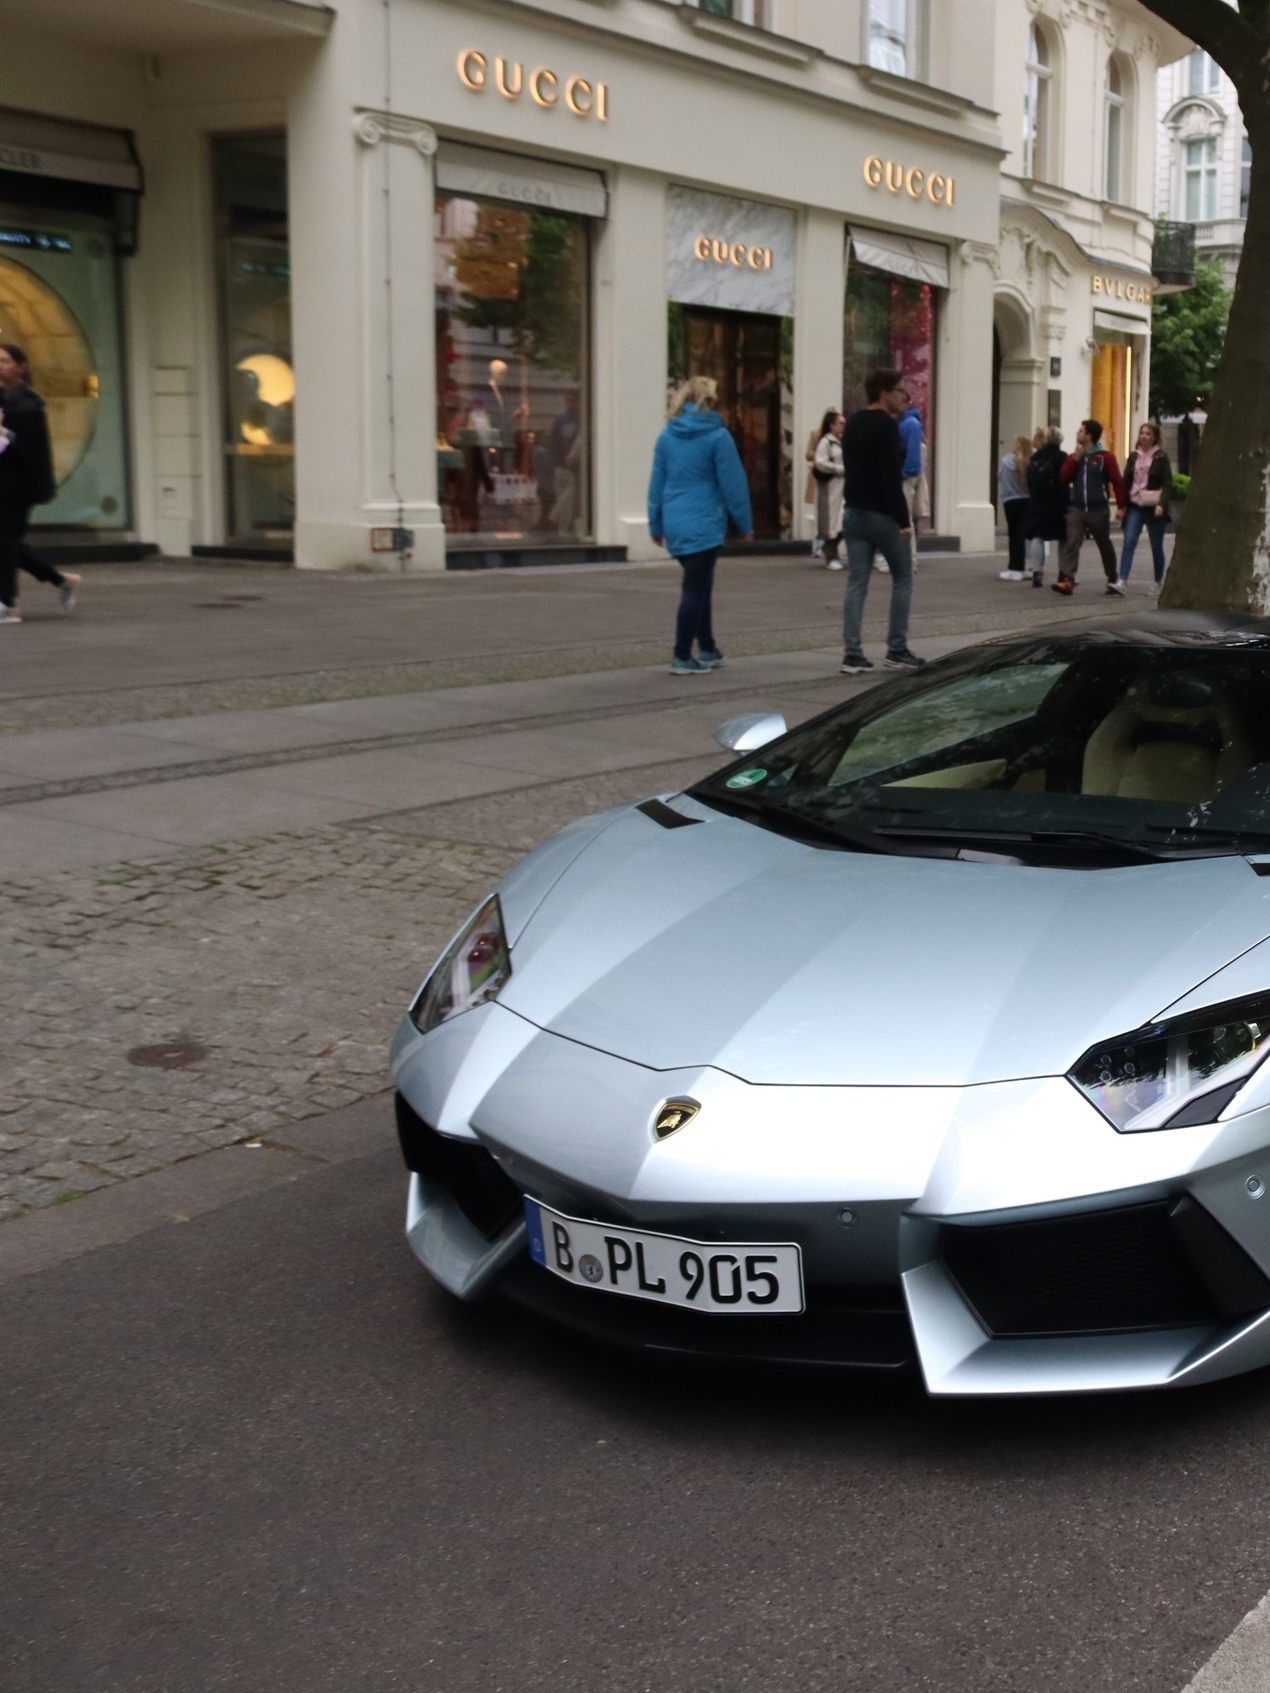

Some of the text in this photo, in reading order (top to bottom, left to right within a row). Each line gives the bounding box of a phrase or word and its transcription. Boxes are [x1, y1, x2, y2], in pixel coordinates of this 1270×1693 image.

[457, 48, 608, 122] GUCCI
[863, 155, 955, 206] GUCCI
[693, 235, 774, 270] GUCCI
[552, 1220, 574, 1273] B
[604, 1235, 666, 1294] PL
[679, 1250, 780, 1305] 905
